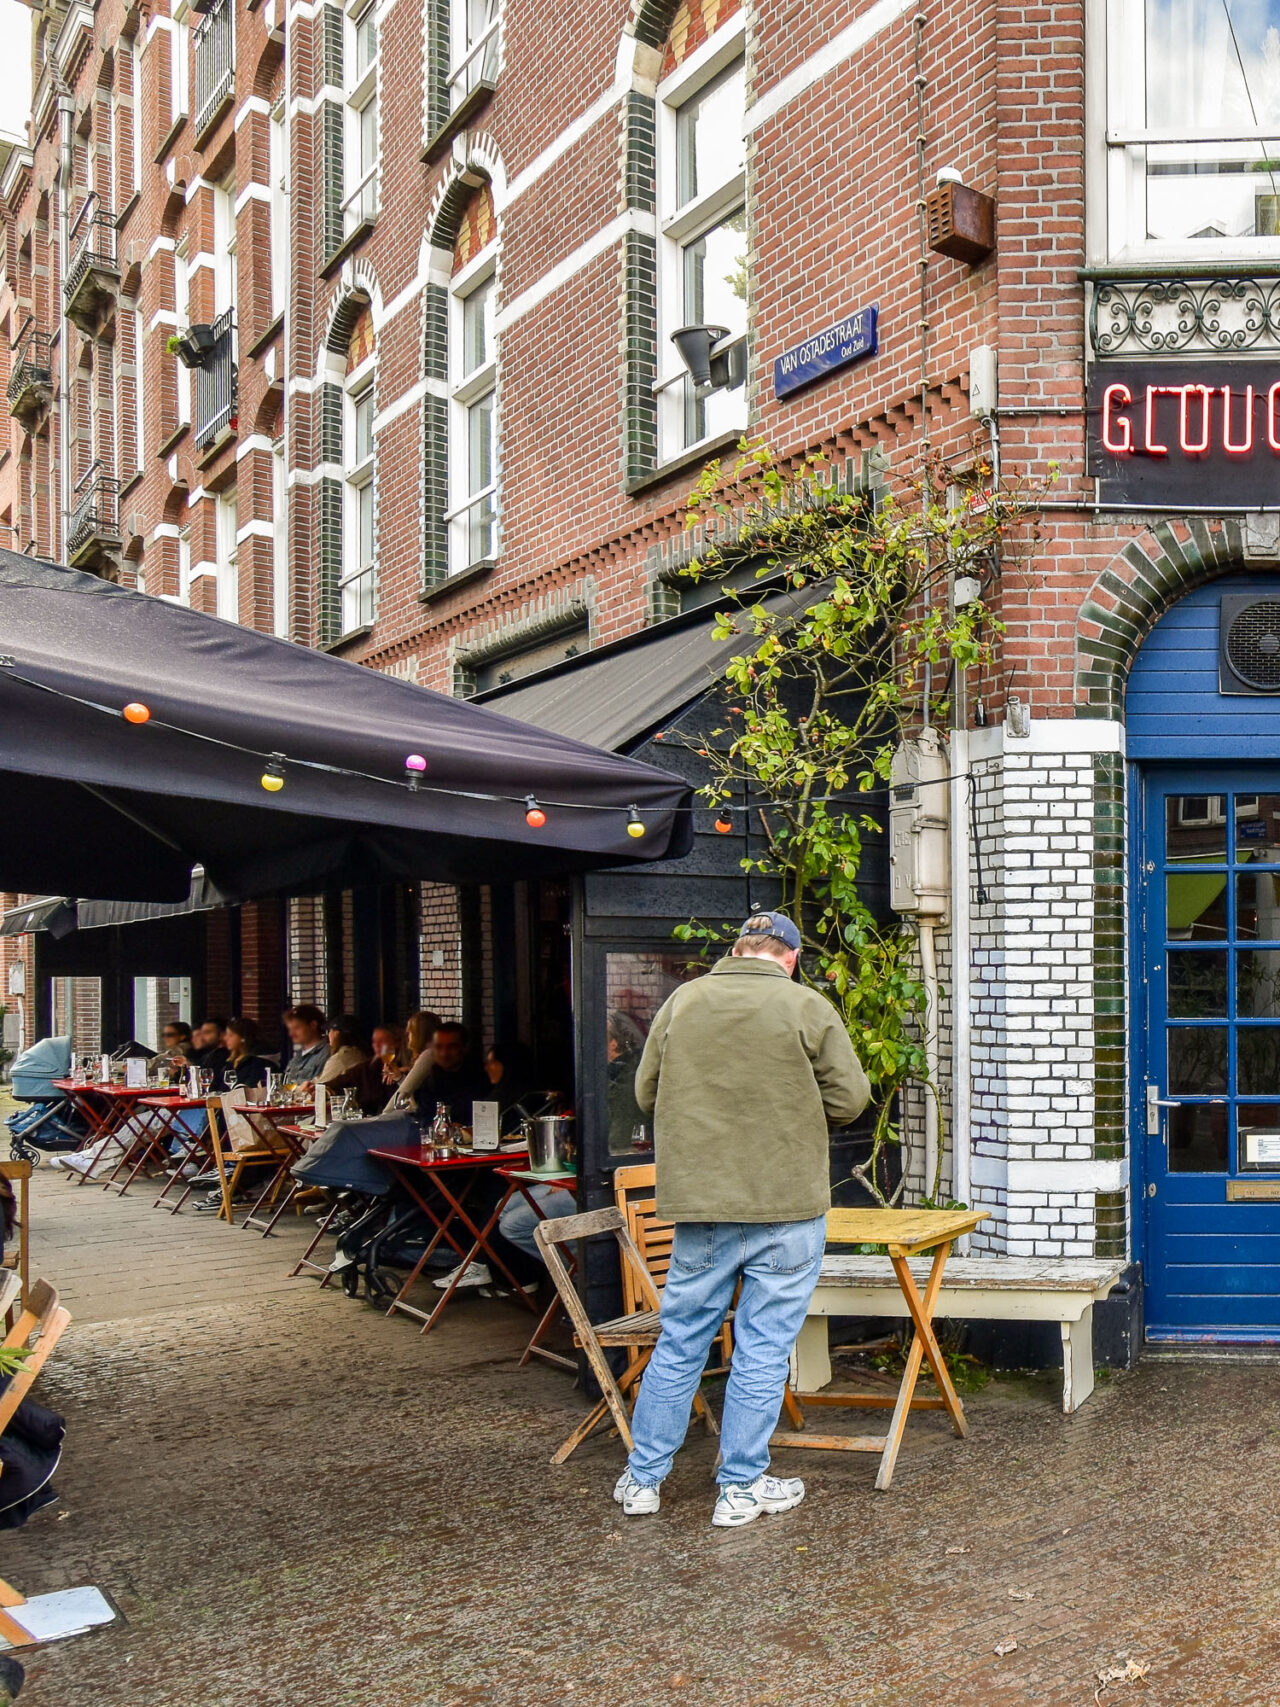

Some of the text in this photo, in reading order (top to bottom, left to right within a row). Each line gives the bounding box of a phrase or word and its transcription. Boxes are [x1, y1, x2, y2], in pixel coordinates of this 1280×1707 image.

[780, 314, 863, 375] VAN OSTADESTRAAT
[841, 336, 864, 358] Oud Zuid
